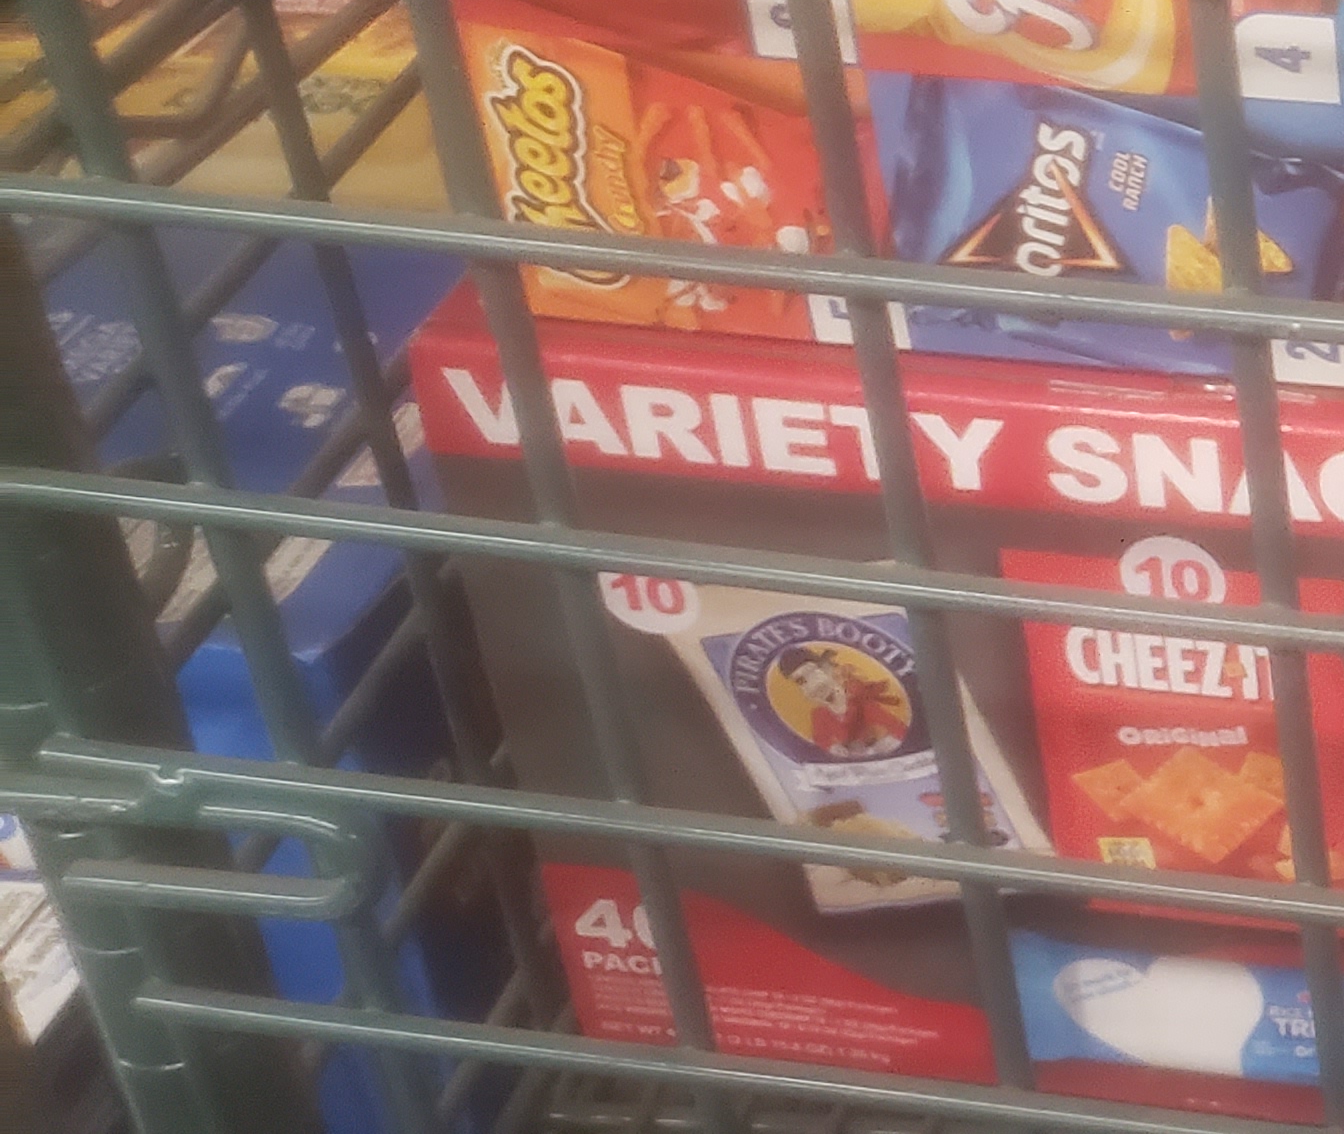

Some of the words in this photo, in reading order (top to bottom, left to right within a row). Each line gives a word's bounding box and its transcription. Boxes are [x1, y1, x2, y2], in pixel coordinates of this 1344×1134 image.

[1255, 45, 1311, 73] 4
[490, 52, 628, 285] heetos
[1108, 152, 1131, 193] COOL
[1122, 152, 1149, 212] RANCH
[1016, 122, 1093, 278] oritos
[442, 366, 1004, 491] VARIETY
[611, 572, 685, 615] 10
[1134, 555, 1211, 603] 10
